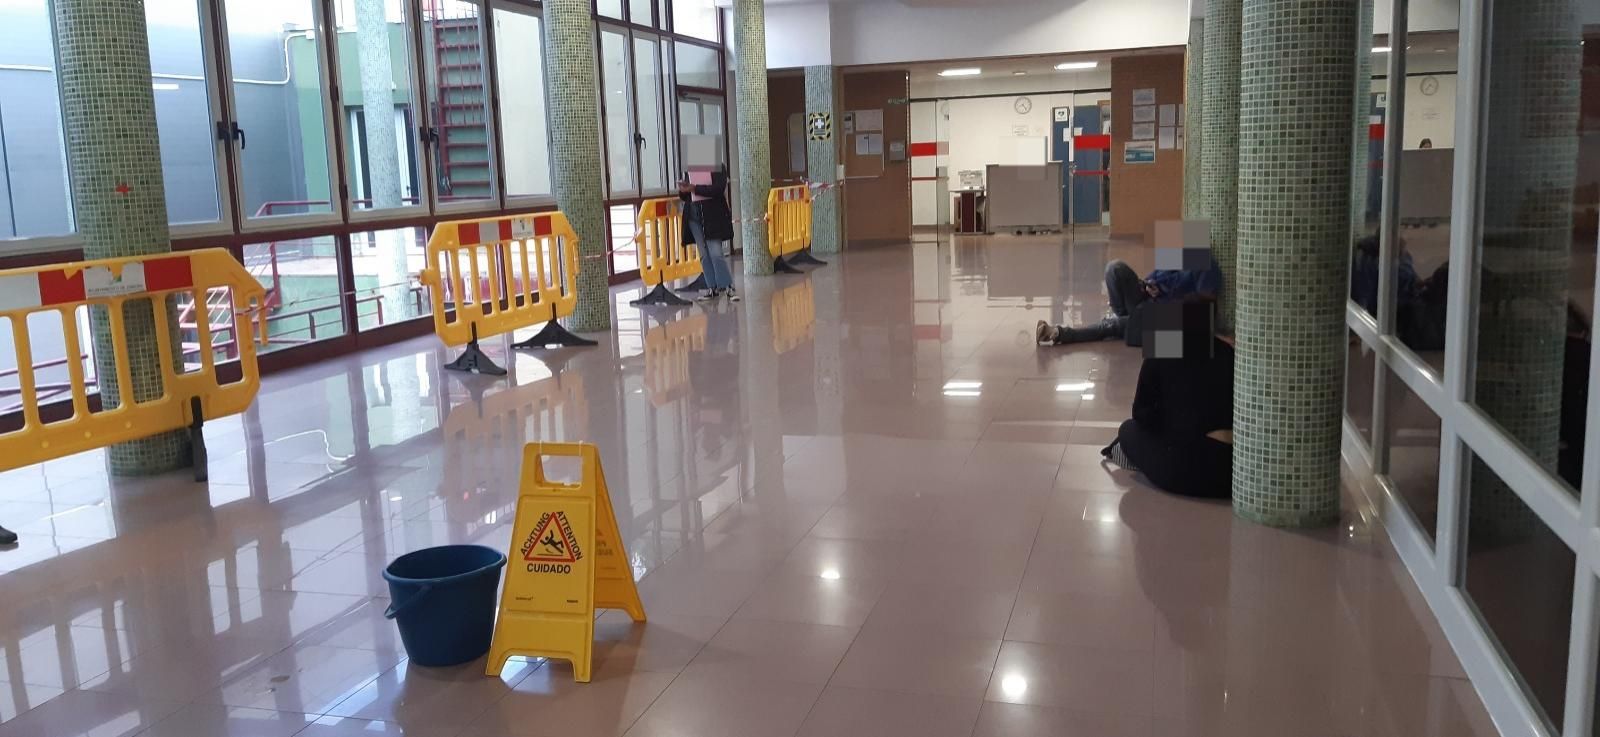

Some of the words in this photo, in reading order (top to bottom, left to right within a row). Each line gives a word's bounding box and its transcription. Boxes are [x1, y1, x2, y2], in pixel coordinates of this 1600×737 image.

[520, 512, 550, 556] ACHTUNG
[556, 510, 583, 560] ATTENTION
[527, 562, 571, 574] CUIDADO
